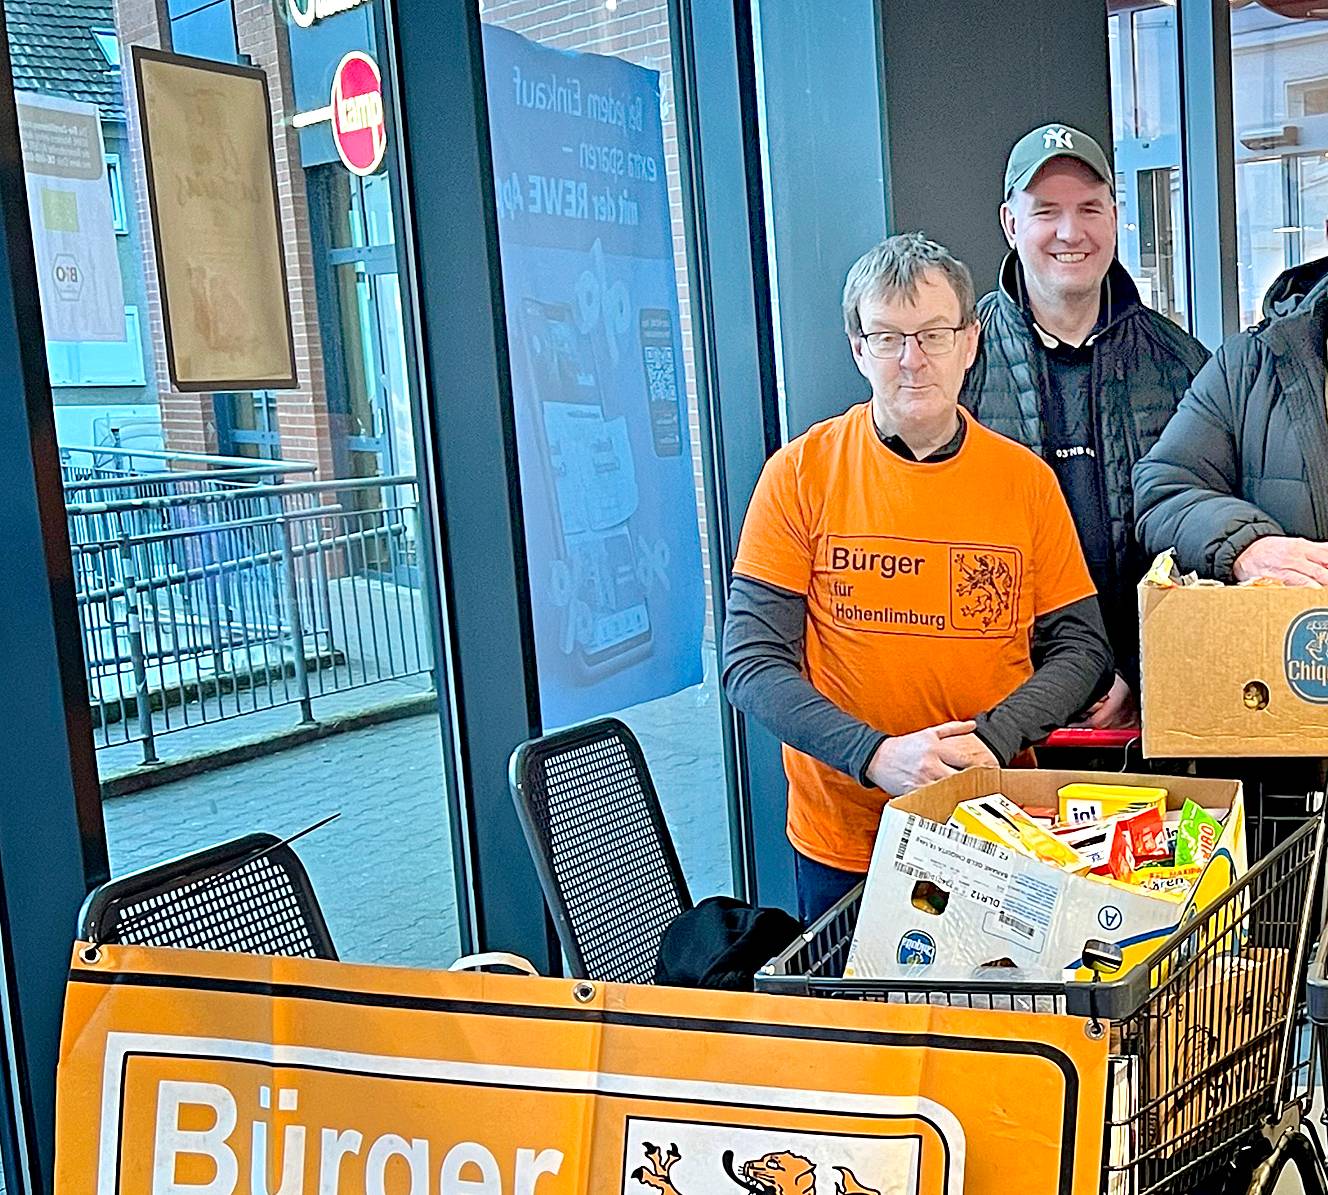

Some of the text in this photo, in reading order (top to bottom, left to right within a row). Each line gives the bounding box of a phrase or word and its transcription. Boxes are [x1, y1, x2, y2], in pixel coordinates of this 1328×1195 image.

[1043, 128, 1073, 148] NY
[832, 547, 925, 578] Bürger
[834, 581, 854, 597] für
[836, 603, 945, 630] Hohenlimburg
[1105, 909, 1118, 926] A
